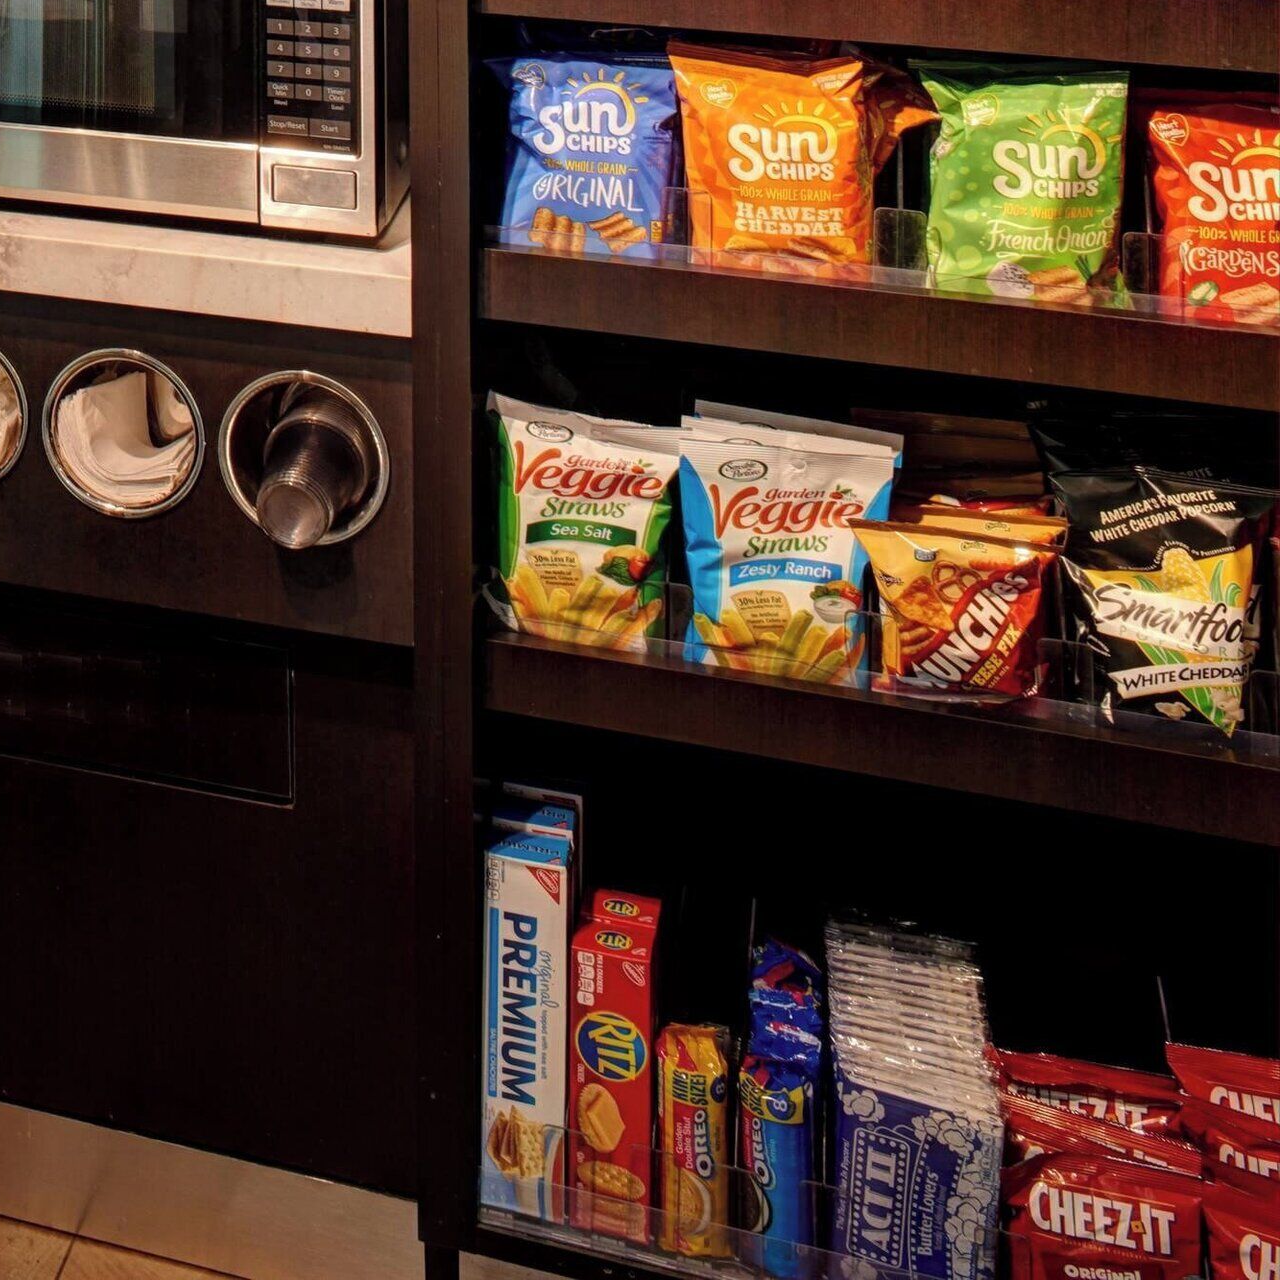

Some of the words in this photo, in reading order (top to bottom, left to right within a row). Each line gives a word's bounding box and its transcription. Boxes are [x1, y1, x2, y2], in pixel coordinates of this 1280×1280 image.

[269, 120, 306, 131] Stop/Reset
[320, 124, 339, 133] Start
[533, 82, 636, 155] Sun
[566, 134, 633, 154] CHIPS
[727, 113, 839, 183] Sun
[991, 124, 1107, 200] Sun
[563, 159, 596, 173] WHOLE
[597, 161, 627, 175] GRAIN
[765, 162, 836, 182] CHIPS
[533, 170, 644, 213] ORIGINAL
[1032, 178, 1100, 199] CHIPS
[734, 218, 845, 237] CHEDDAR
[735, 201, 845, 220] HARVEST
[1198, 227, 1227, 241] 100%
[1230, 229, 1267, 243] WHOLE
[513, 440, 663, 500] Veggie
[540, 496, 626, 519] Straws
[709, 483, 864, 540] Veggie
[761, 487, 826, 503] garden
[1099, 494, 1160, 524] AMERICA'S
[1160, 489, 1218, 509] FAVORITE
[549, 523, 579, 536] Sea
[582, 525, 613, 541] Salt
[1090, 525, 1130, 543] WHITE
[1129, 510, 1178, 533] CHEDDAR
[1178, 500, 1236, 518] POPCORN
[743, 534, 829, 558] Straws
[737, 564, 782, 578] Zesty
[784, 561, 832, 579] Ranch
[538, 950, 560, 1009] original
[501, 910, 538, 1107] PREMIUM
[586, 1012, 638, 1081] RITZ
[672, 1071, 690, 1102] KING
[694, 1109, 713, 1178] OREO
[751, 1116, 771, 1186] OREO
[918, 1170, 940, 1214] Lovers
[916, 1213, 934, 1257] Butter
[1028, 1180, 1176, 1256] CHEEZ-IT
